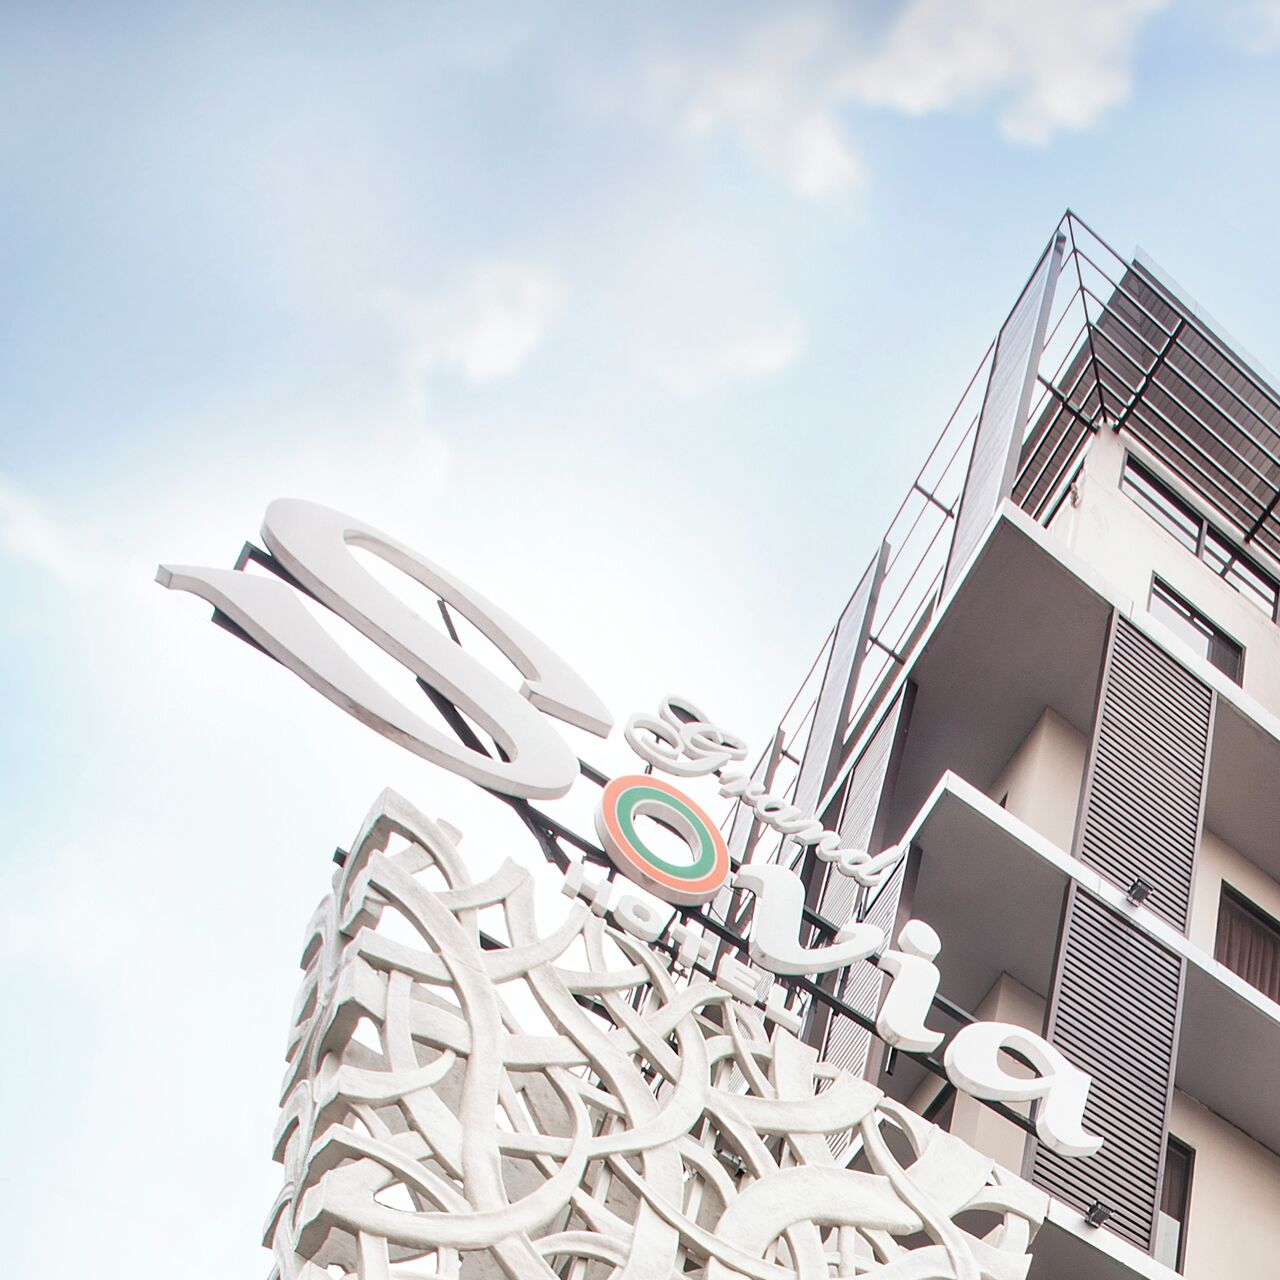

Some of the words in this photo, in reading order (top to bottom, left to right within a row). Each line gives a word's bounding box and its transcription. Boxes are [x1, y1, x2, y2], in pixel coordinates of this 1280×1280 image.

[156, 497, 1104, 1157] Sovia
[623, 694, 907, 888] Grand
[561, 857, 806, 1034] HOTEL
